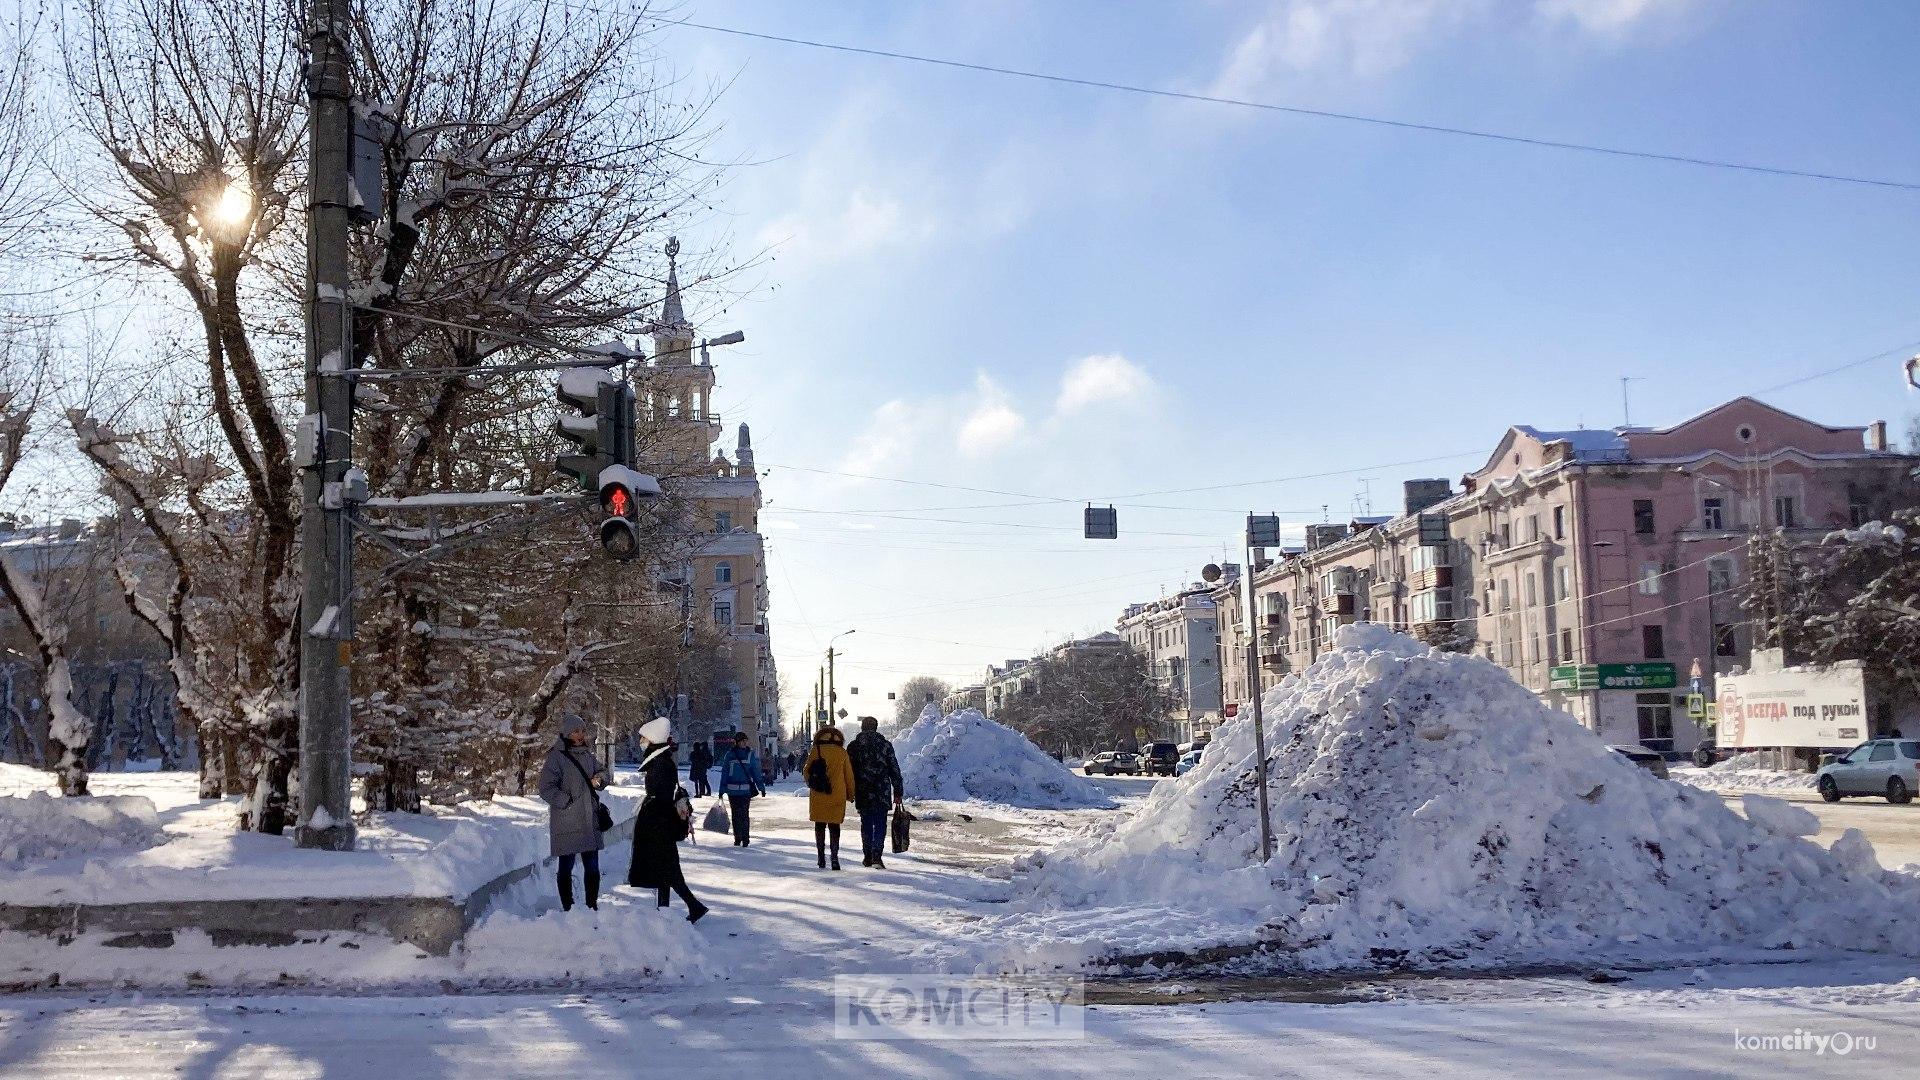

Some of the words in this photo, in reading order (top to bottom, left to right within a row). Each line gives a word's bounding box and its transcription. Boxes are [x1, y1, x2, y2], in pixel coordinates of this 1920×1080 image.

[1746, 702, 1788, 722] ВСЕГДА
[1793, 704, 1816, 720] под
[1822, 698, 1860, 721] рукой
